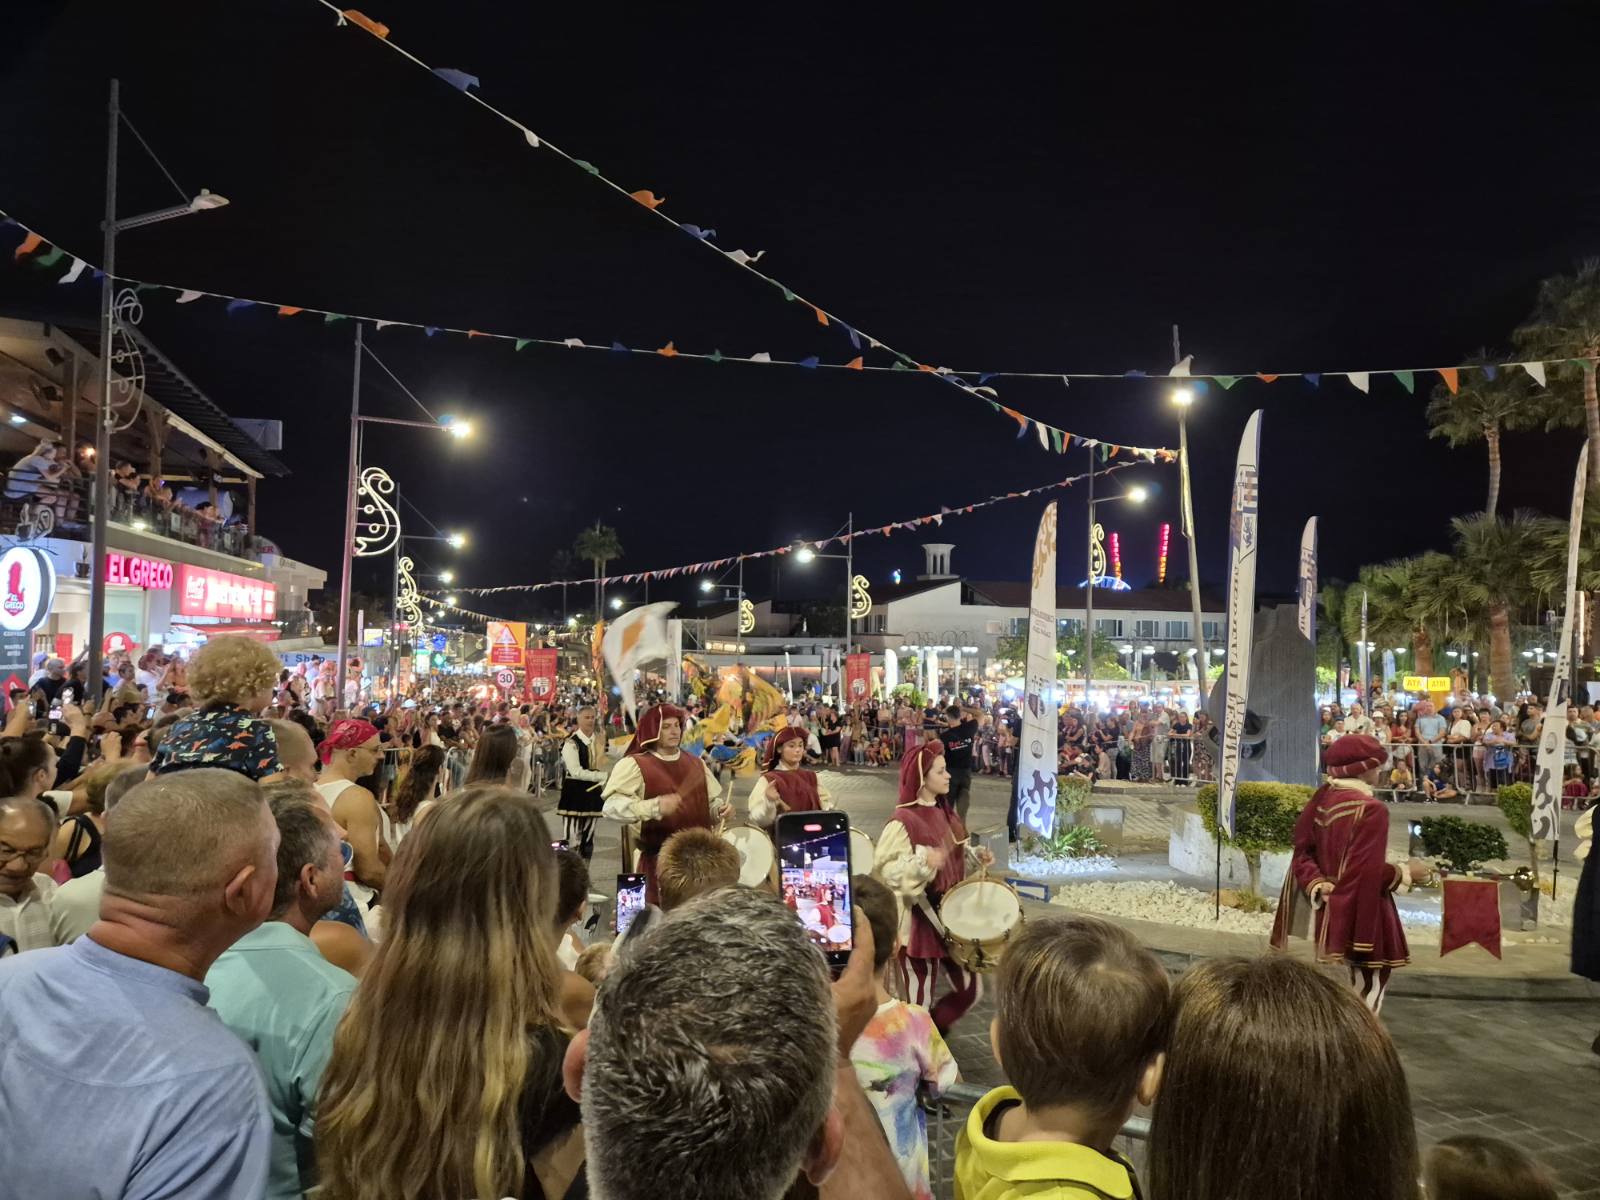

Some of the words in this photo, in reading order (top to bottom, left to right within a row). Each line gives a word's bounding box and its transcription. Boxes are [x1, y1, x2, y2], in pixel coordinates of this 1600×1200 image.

[107, 554, 130, 585] EL
[129, 557, 173, 590] GRECO
[5, 601, 24, 609] GRECO
[296, 653, 326, 665] Shp
[499, 673, 513, 684] 30
